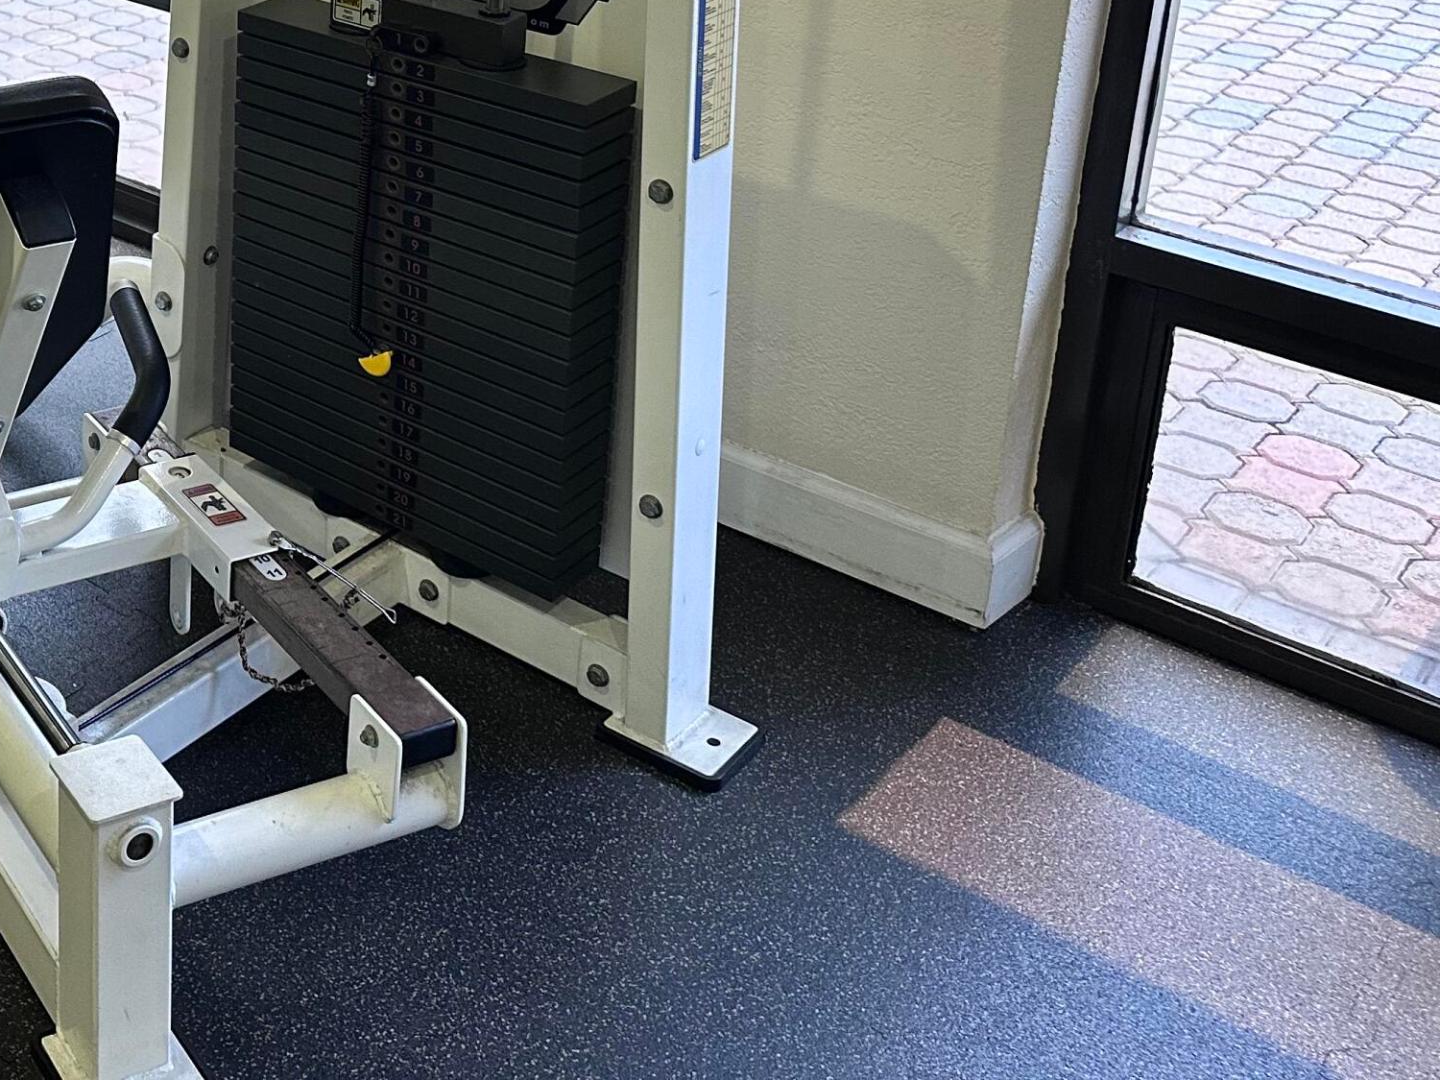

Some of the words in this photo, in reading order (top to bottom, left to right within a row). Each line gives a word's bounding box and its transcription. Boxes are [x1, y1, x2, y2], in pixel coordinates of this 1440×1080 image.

[416, 63, 425, 78] 2
[416, 89, 425, 103] 3
[415, 138, 423, 153] 5
[415, 166, 425, 179] 6
[415, 191, 423, 203] 7
[412, 214, 421, 228] 8
[411, 239, 419, 251] 9
[406, 259, 421, 275] 10
[407, 284, 420, 299] 11
[404, 307, 418, 323] 12
[404, 329, 417, 346] 13
[403, 378, 417, 394] 15
[401, 400, 415, 416] 16
[400, 423, 414, 437] 17
[397, 468, 411, 482] 19
[393, 491, 409, 506] 20
[254, 554, 271, 564] 10
[267, 568, 283, 578] 11
